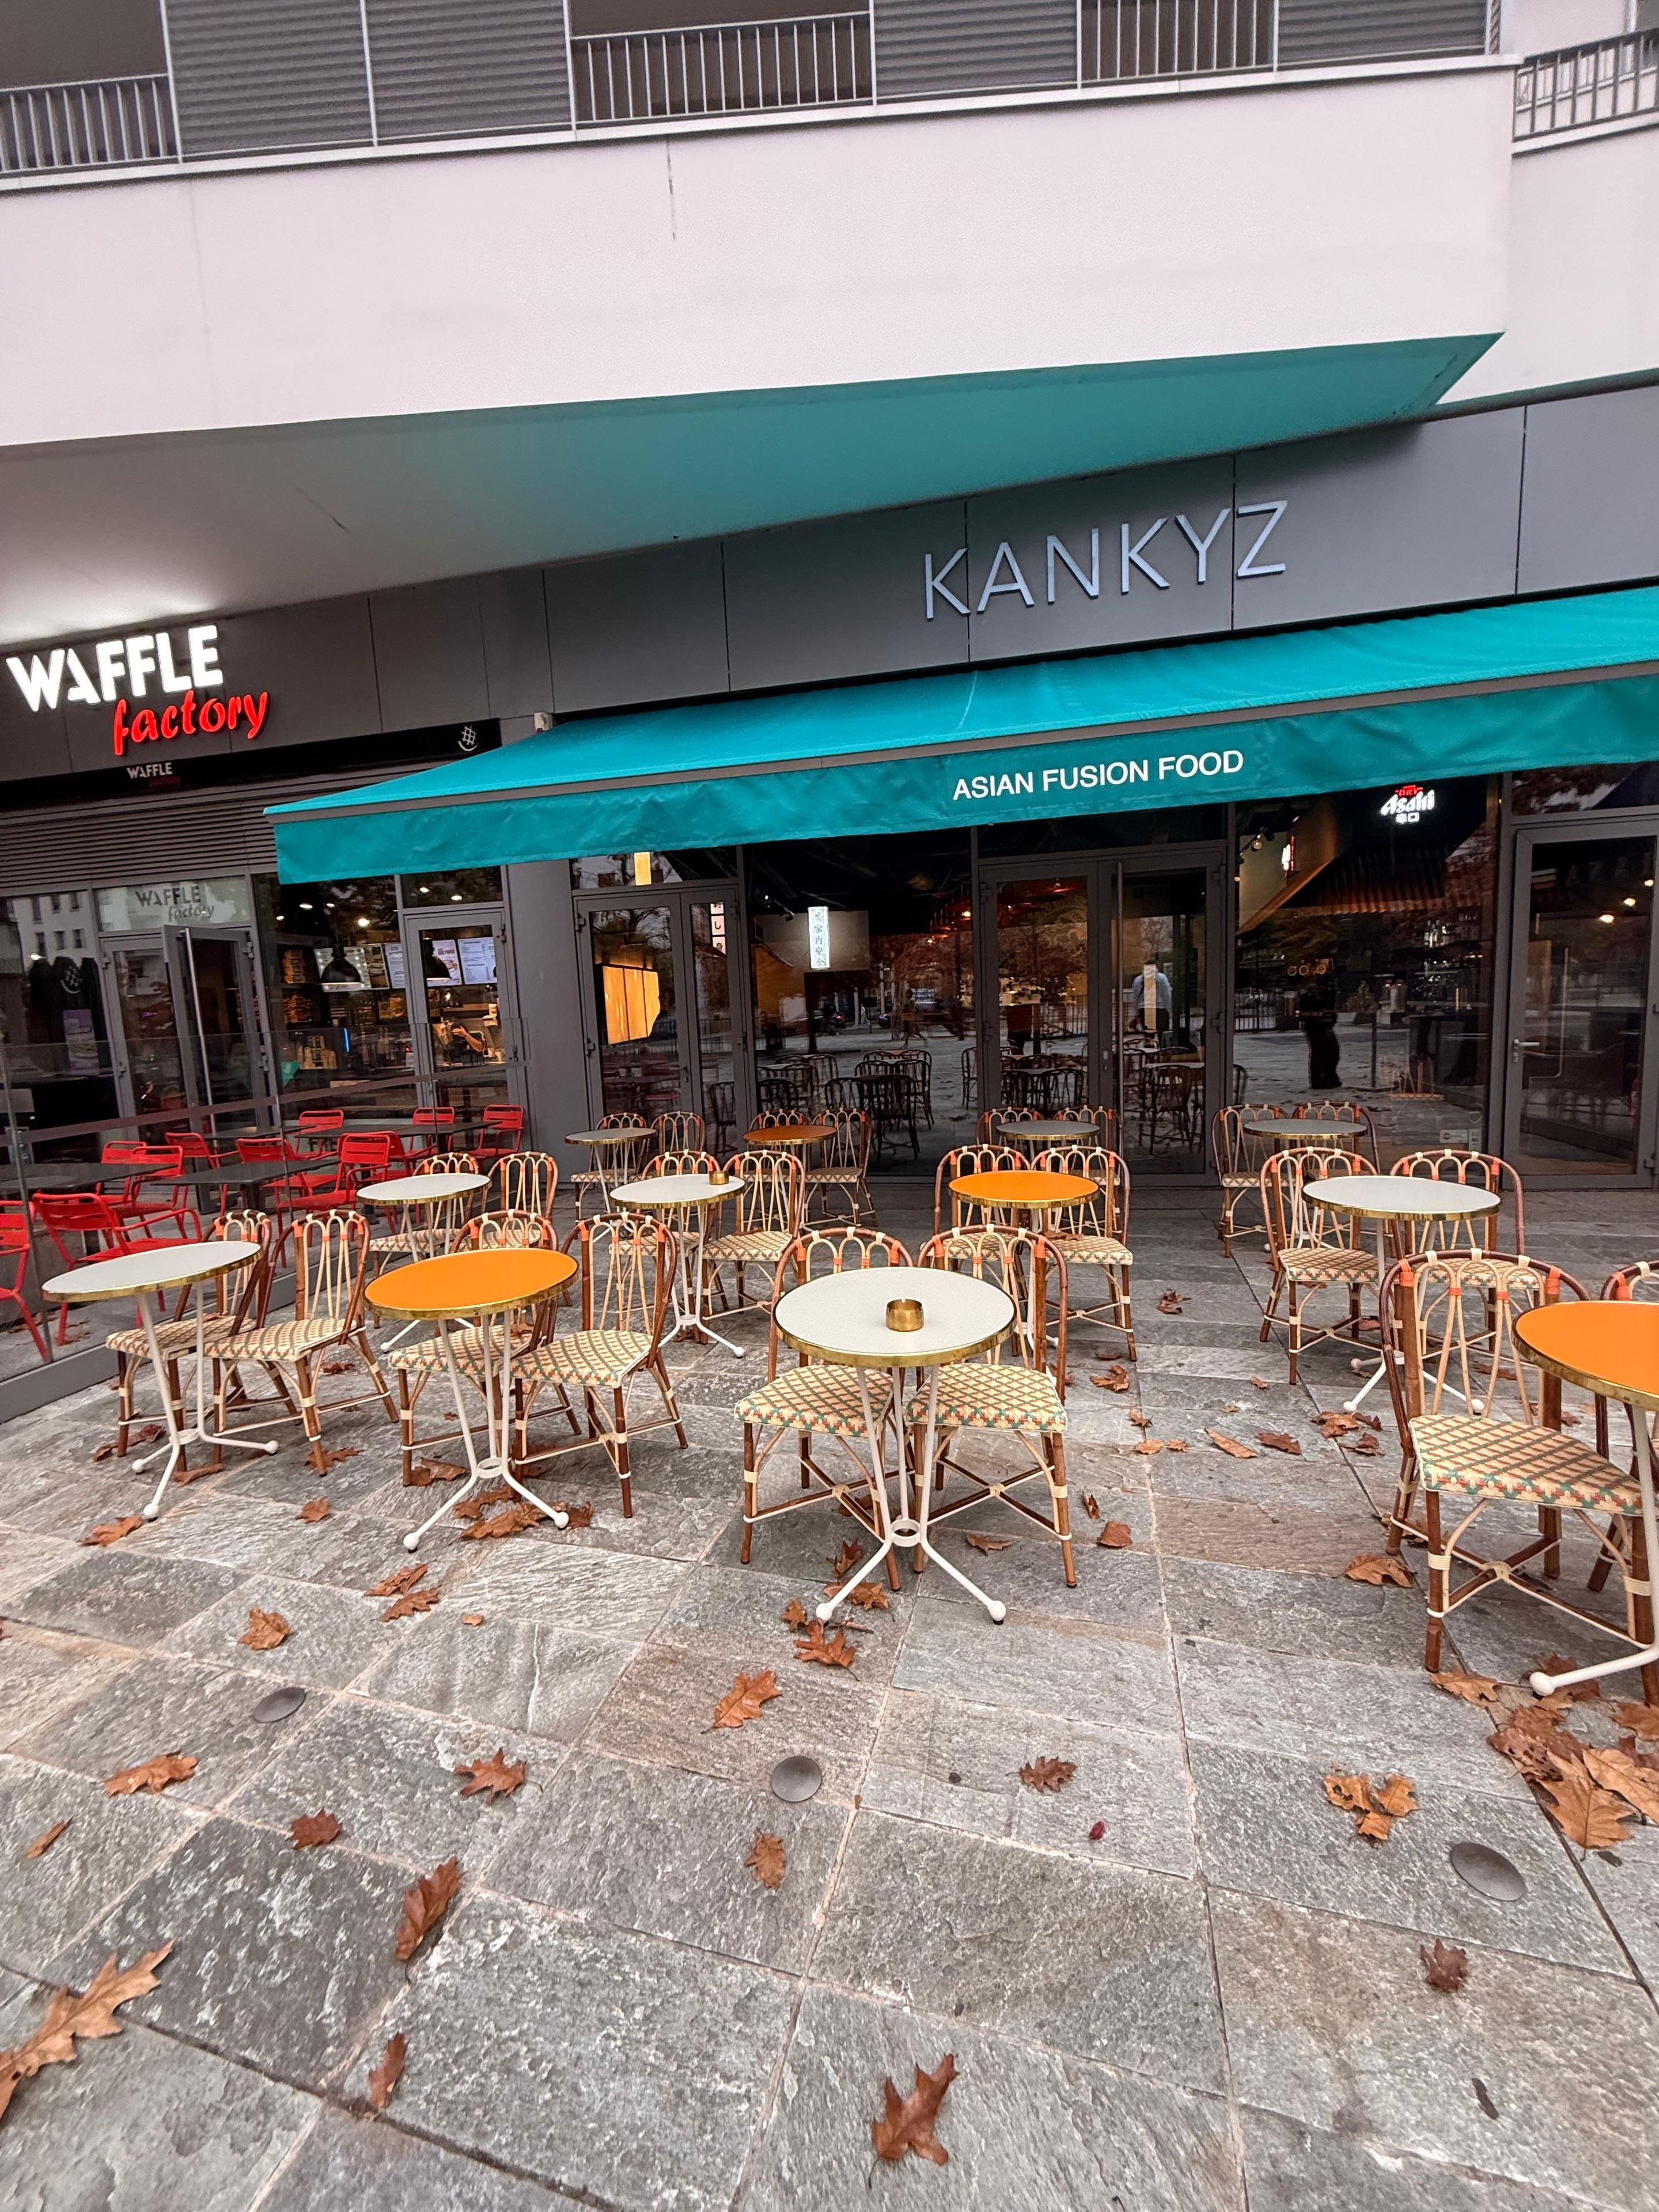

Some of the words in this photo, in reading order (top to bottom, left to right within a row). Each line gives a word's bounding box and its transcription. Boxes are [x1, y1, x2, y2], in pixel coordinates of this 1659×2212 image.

[925, 500, 1288, 620] KANKYZ
[6, 624, 224, 713] WAFFLE
[113, 690, 268, 757] factory
[127, 762, 173, 779] WAFFLE
[952, 772, 1033, 800] ASIAN
[1043, 760, 1149, 791] FUSION
[1158, 749, 1244, 780] FOOD
[1380, 790, 1435, 816] Asahi
[135, 886, 201, 907] WAFFLE
